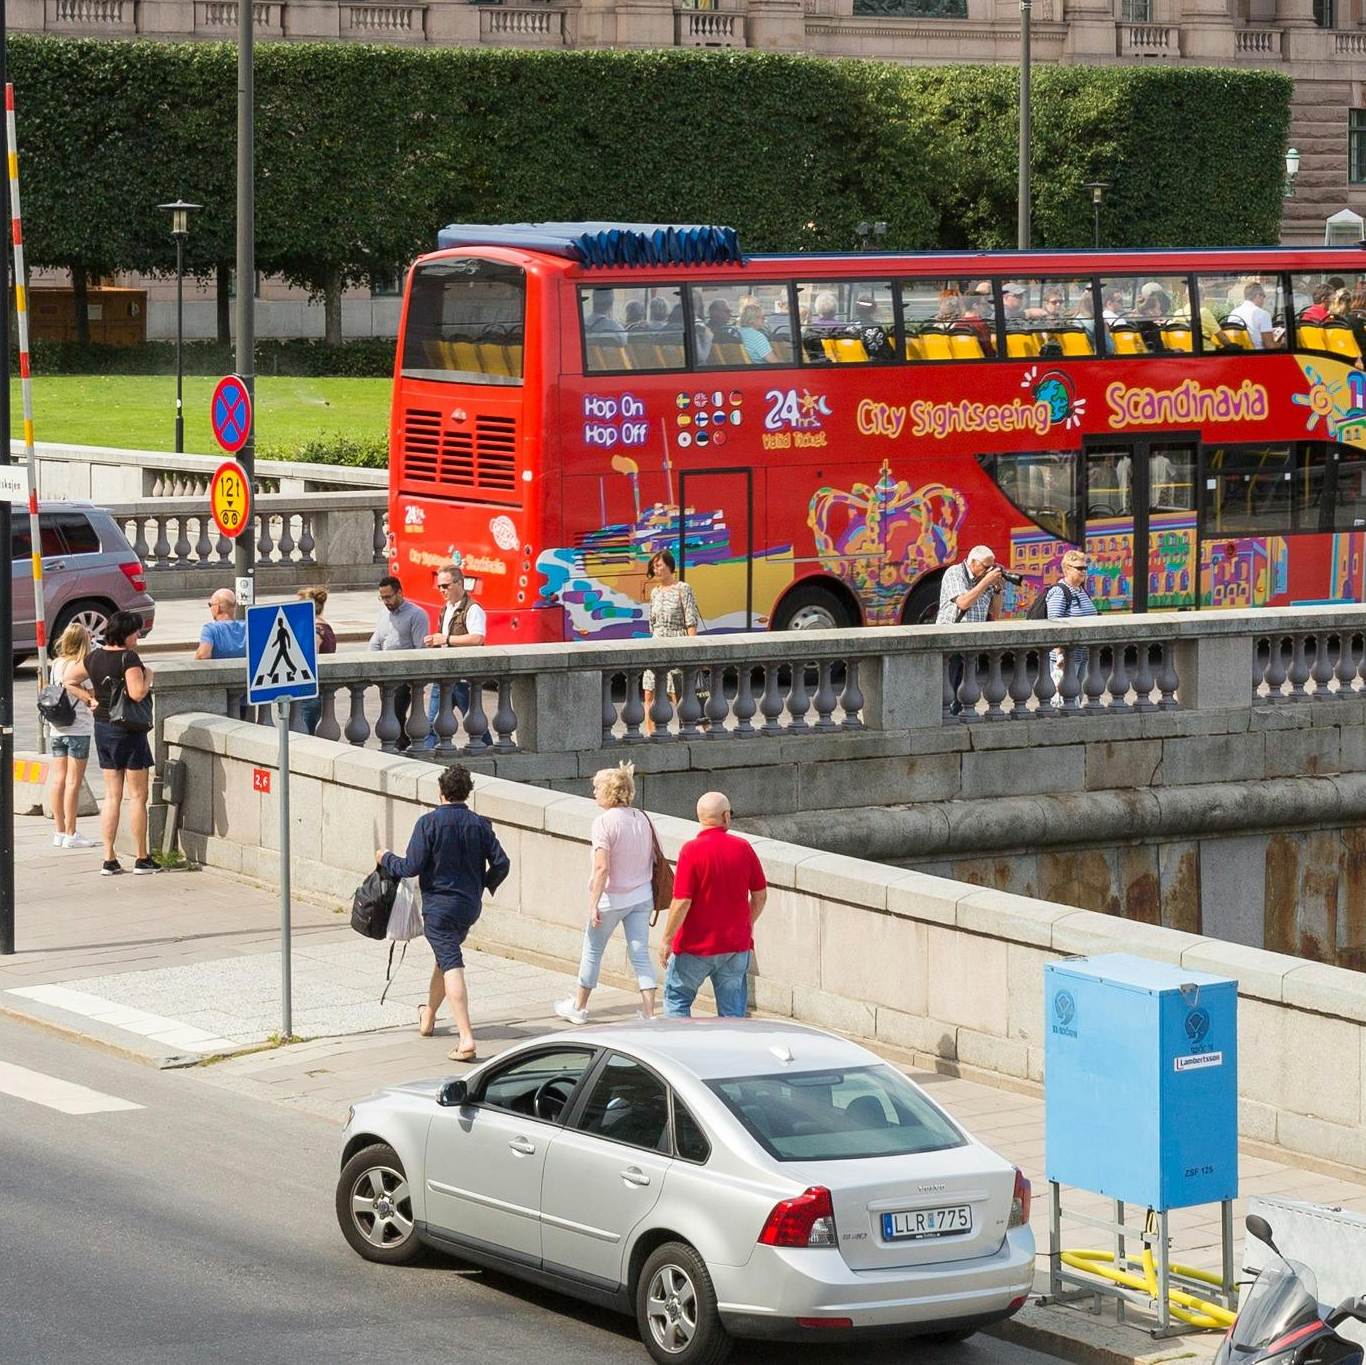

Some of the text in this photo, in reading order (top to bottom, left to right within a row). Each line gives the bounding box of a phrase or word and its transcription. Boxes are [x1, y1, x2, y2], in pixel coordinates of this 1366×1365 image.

[584, 393, 645, 420] Hop On
[1106, 379, 1269, 429] Scandinavia
[857, 398, 1052, 439] City Sightseeing
[584, 420, 649, 447] Hop Off
[1185, 1165, 1214, 1178] ZSF 125
[894, 1208, 968, 1234] LLR 775
